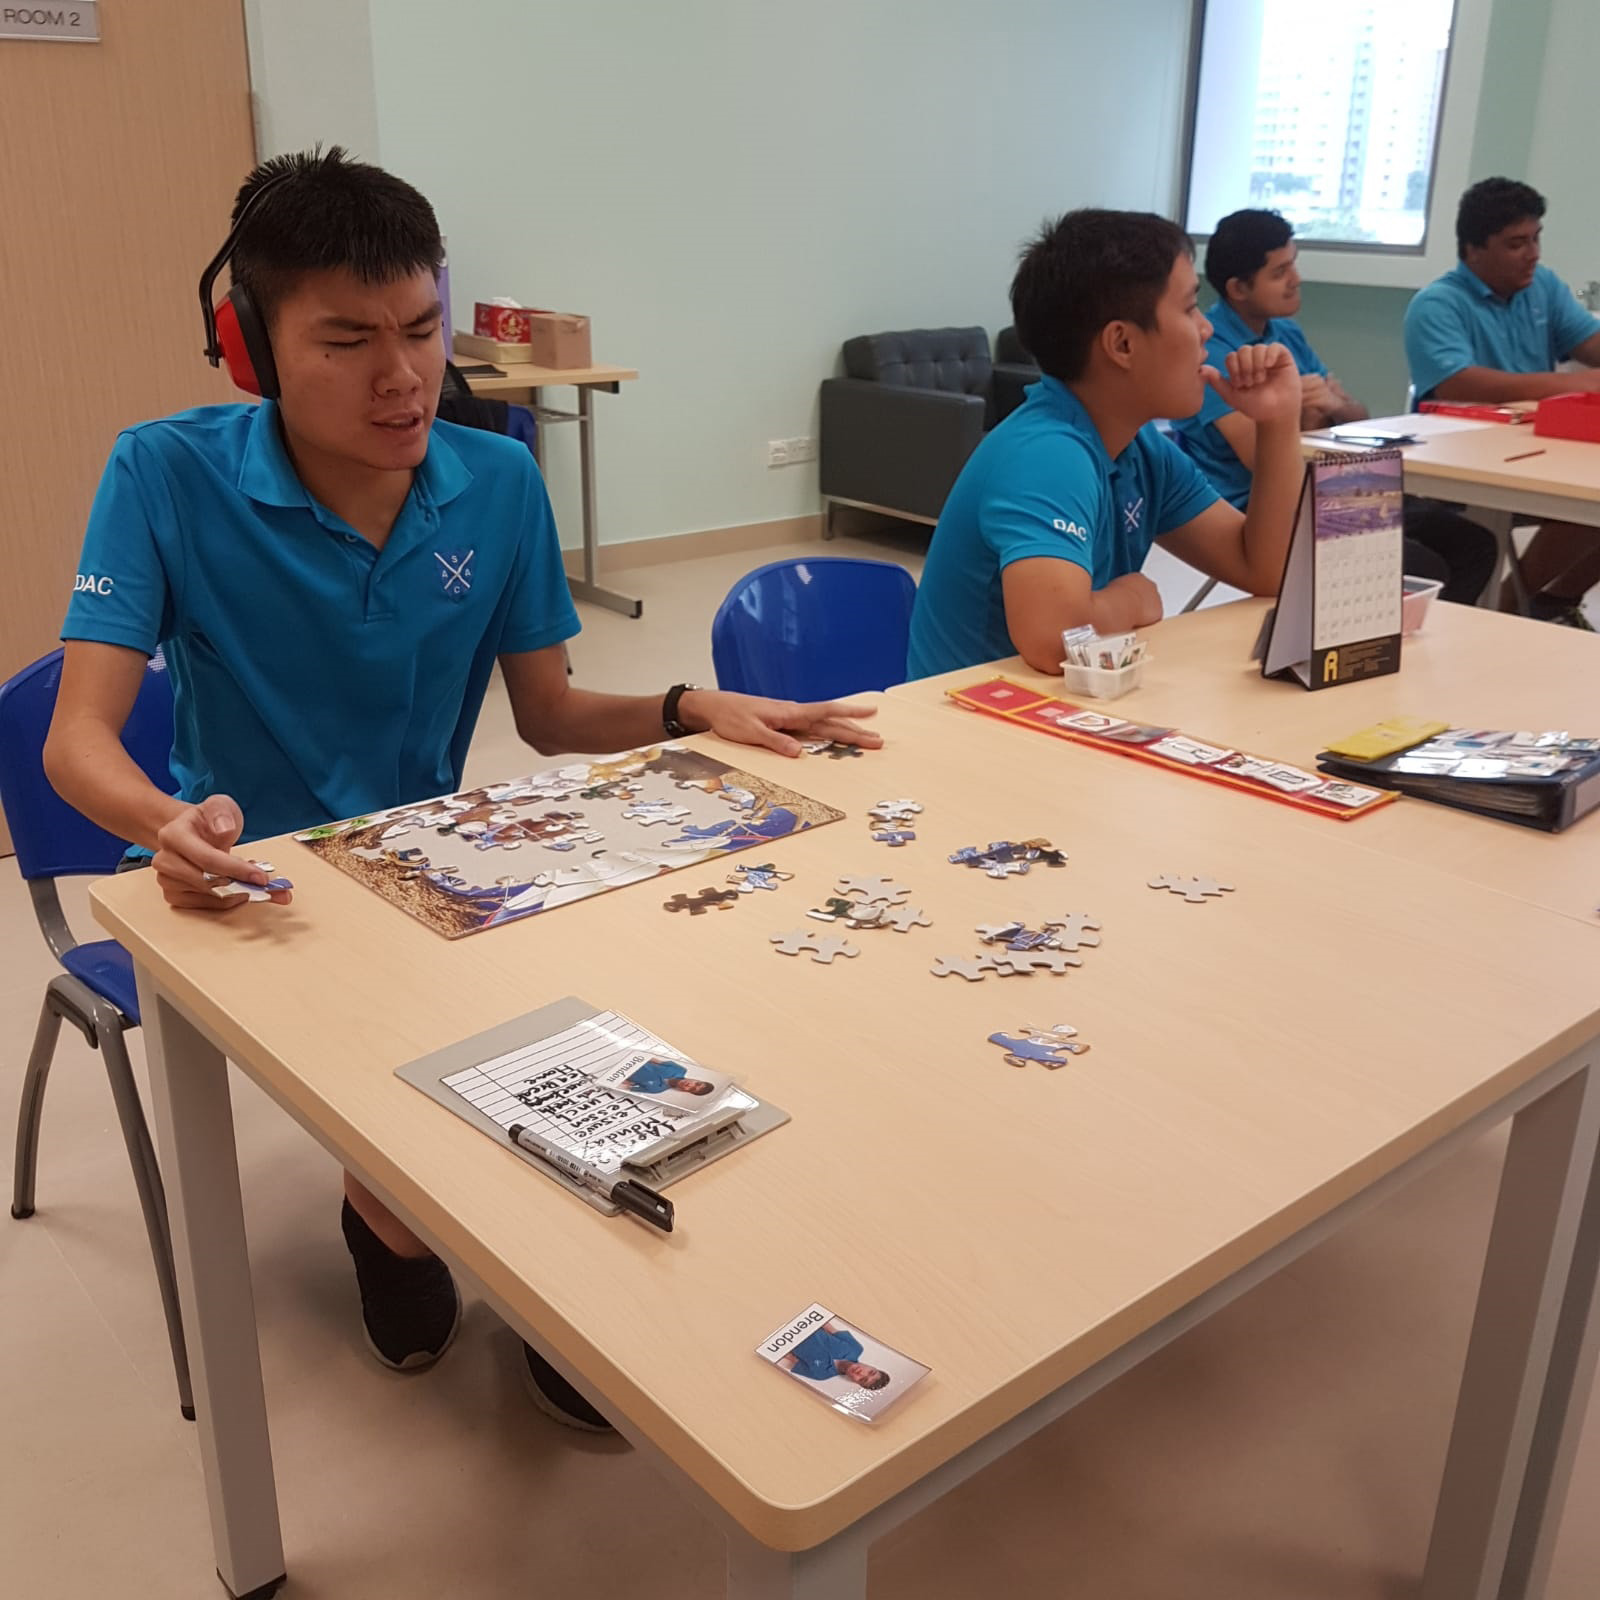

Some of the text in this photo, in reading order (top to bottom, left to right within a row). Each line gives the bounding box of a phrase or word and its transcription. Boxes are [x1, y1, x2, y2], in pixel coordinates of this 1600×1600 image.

[3, 8, 81, 27] ROOM 2
[1053, 519, 1087, 541] DAC
[72, 574, 114, 596] DAC
[523, 1064, 574, 1085] Home
[556, 1068, 588, 1084] Tea
[606, 1055, 644, 1083] Brendon
[555, 1092, 615, 1122] Lunch
[570, 1097, 634, 1128] Lesson
[582, 1116, 660, 1159] Monday
[767, 1310, 824, 1352] Brendon
